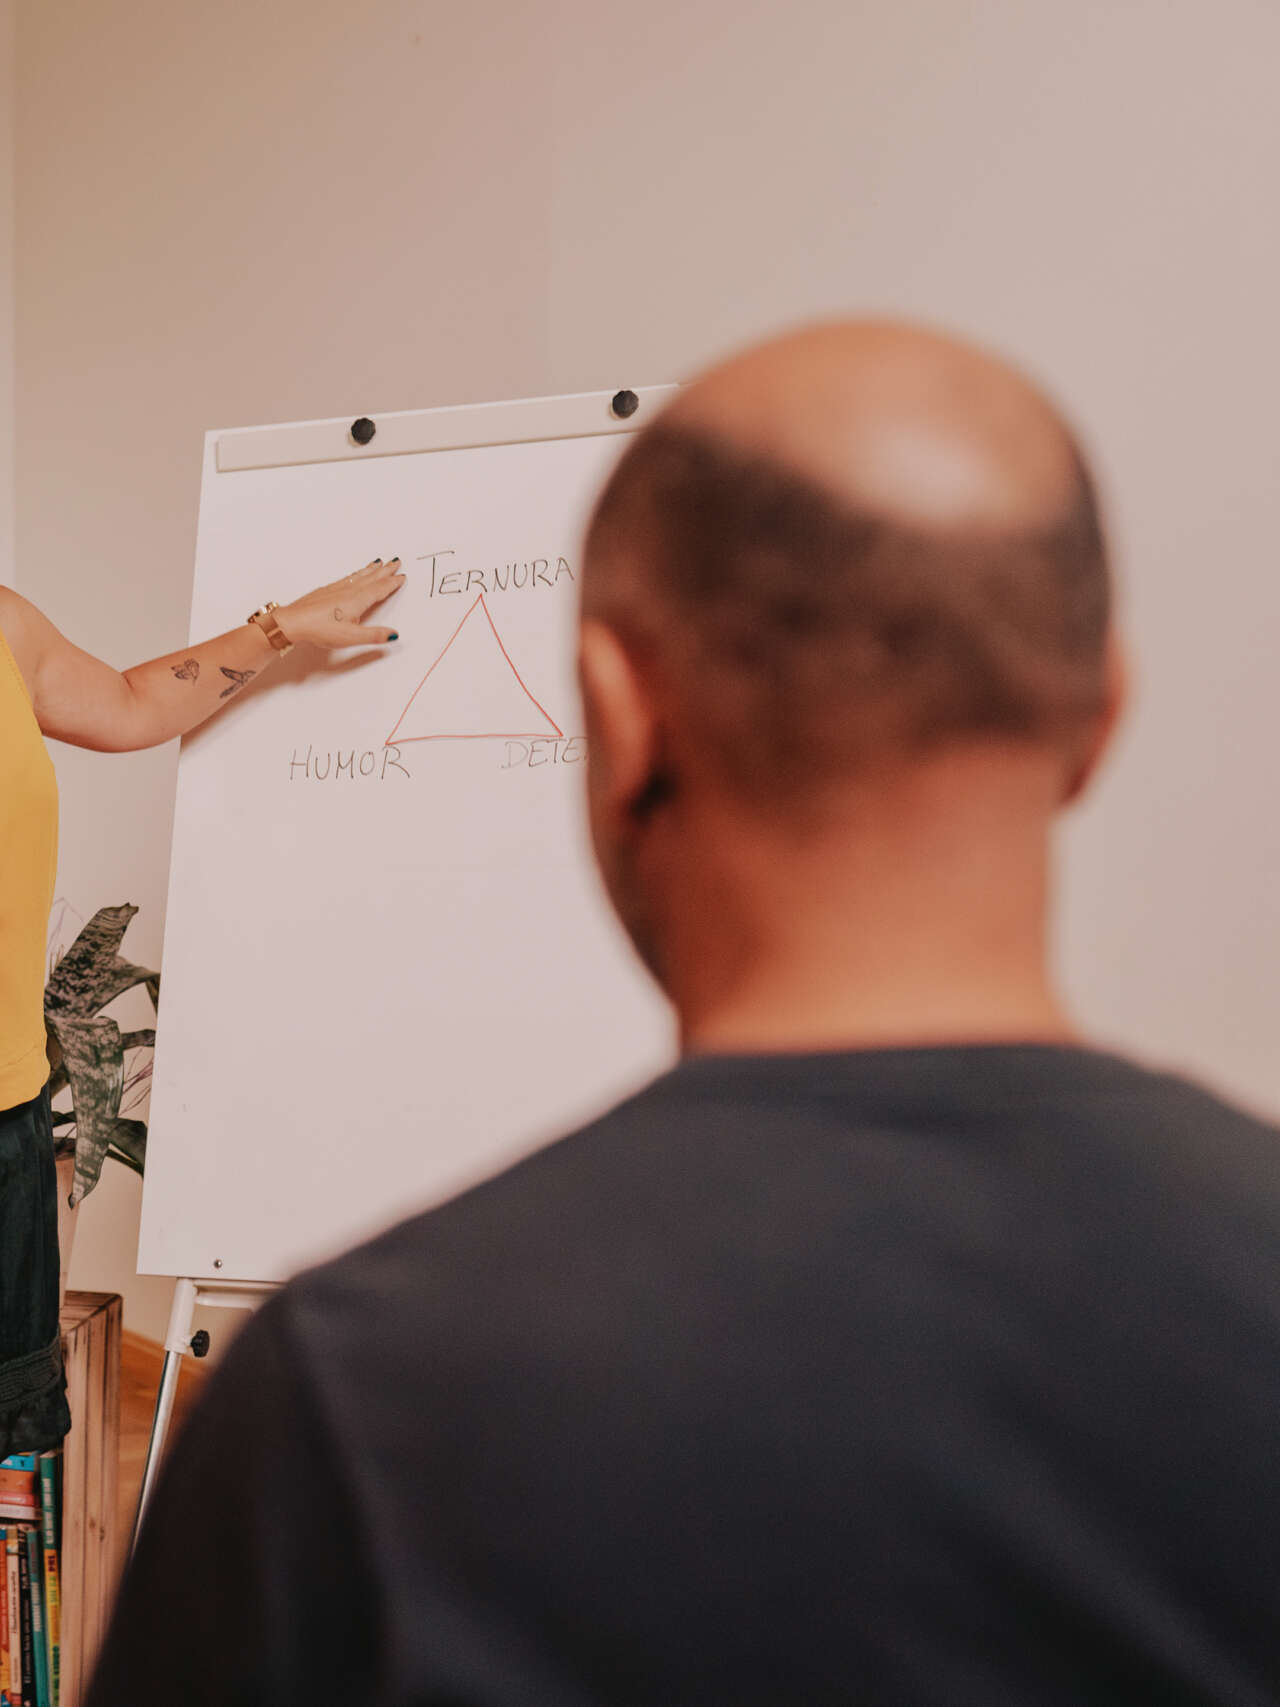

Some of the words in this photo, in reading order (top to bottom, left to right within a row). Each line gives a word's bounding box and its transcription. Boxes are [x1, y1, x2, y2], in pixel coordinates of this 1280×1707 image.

[416, 550, 575, 598] TERNURA
[288, 744, 411, 781] HUMOR
[499, 736, 588, 769] DETE
